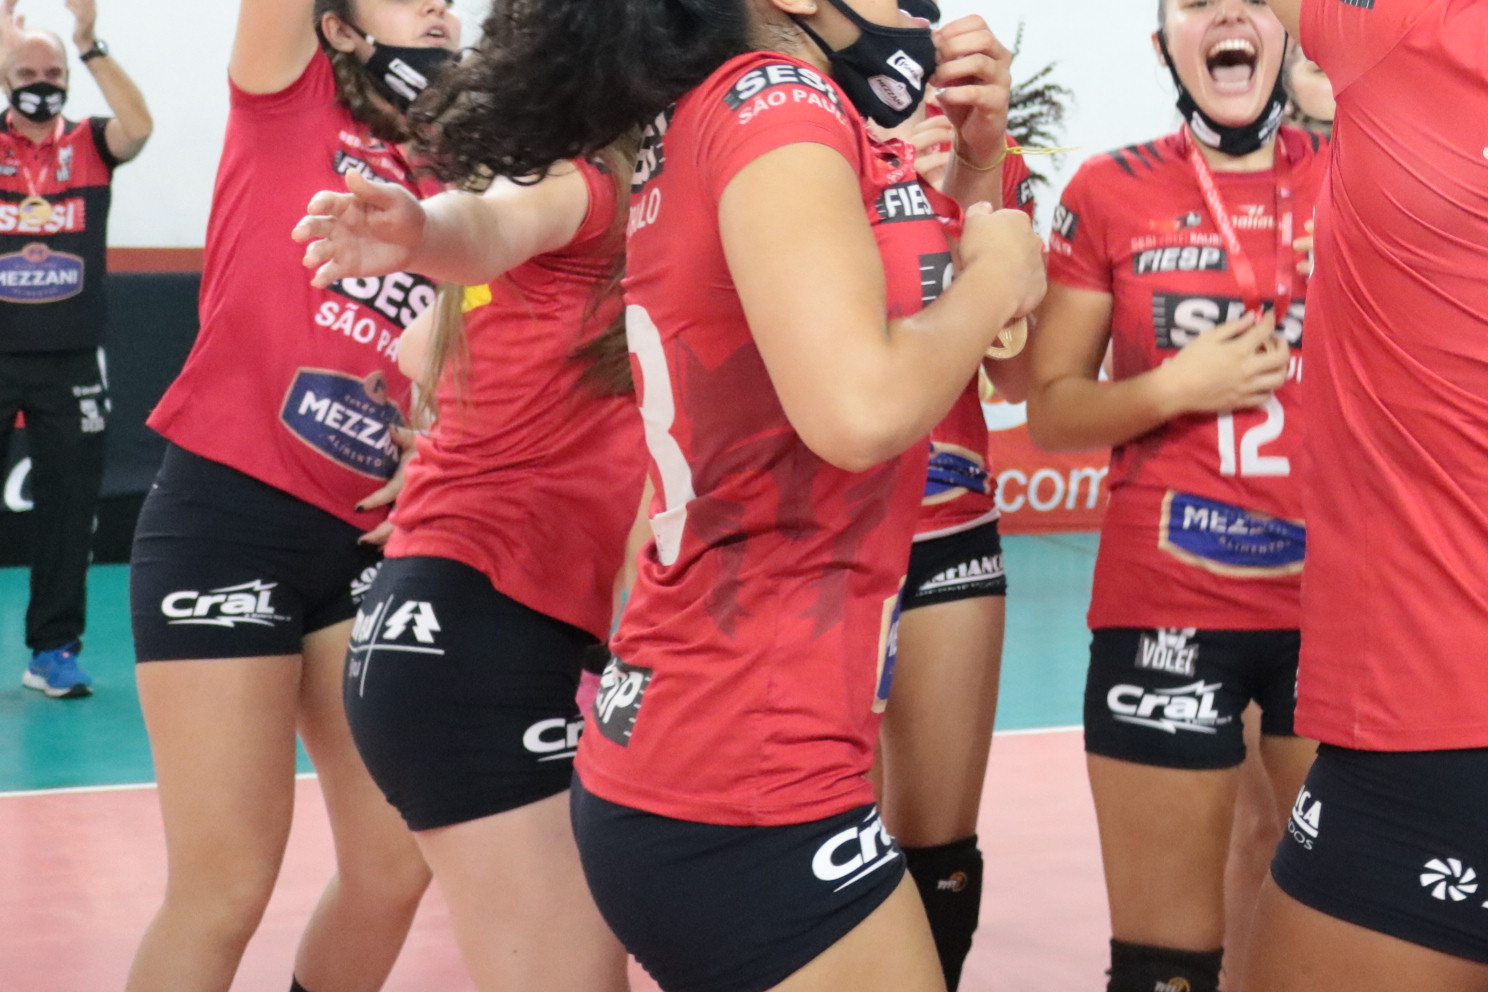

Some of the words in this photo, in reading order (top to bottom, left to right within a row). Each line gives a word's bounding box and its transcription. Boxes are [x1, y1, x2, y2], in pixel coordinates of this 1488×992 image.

[738, 91, 787, 125] SÃO
[1138, 246, 1221, 273] FIESP
[314, 301, 376, 344] SÃO
[1217, 394, 1291, 478] 12
[161, 588, 275, 618] Cral
[1106, 683, 1219, 719] Cral
